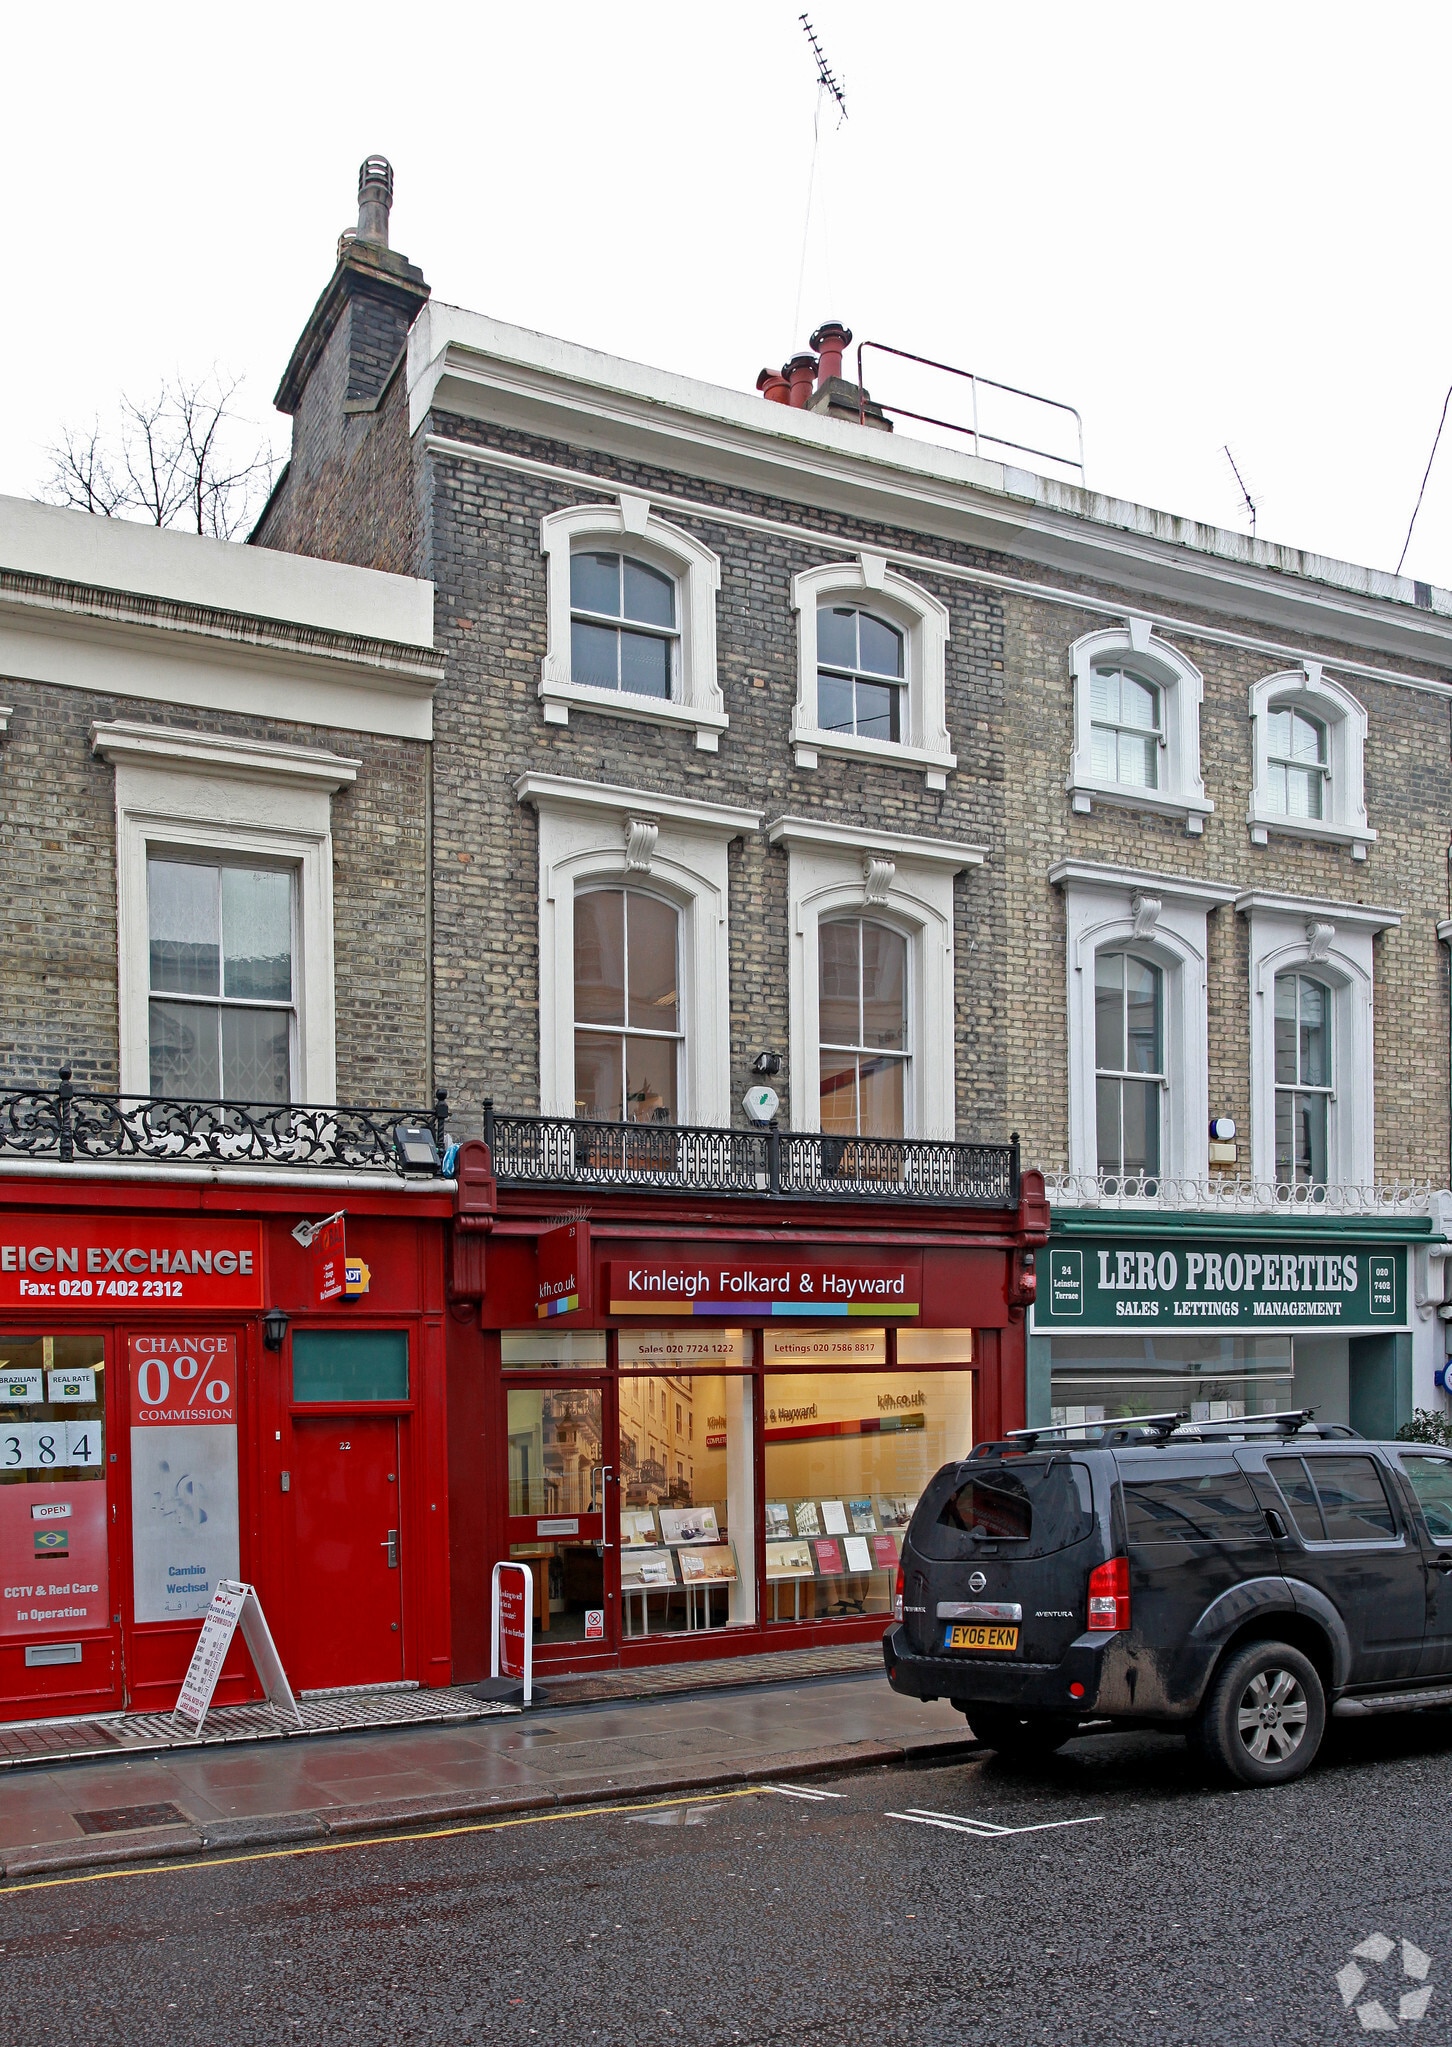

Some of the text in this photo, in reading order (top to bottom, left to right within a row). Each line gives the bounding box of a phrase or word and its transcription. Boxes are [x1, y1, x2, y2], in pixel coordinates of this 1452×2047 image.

[569, 1227, 576, 1237] 23
[1, 1246, 253, 1275] EIGN EXCHANGE
[1061, 1265, 1072, 1275] 24
[1097, 1250, 1358, 1292] LERO PROPERTIES
[1375, 1268, 1389, 1276] 020
[19, 1279, 183, 1297] Fax: 020 7402 2312
[539, 1273, 576, 1298] kfh.co.uk
[628, 1269, 905, 1298] Kinleigh Folkard & Hayward
[1053, 1279, 1080, 1288] Leinster
[1374, 1281, 1391, 1290] 7402
[1054, 1291, 1079, 1300] Terrace
[1374, 1294, 1391, 1303] 7768
[1115, 1300, 1342, 1317] SALES LETTINGS MANAGEMENT
[135, 1337, 228, 1353] CHANGE
[638, 1344, 734, 1354] Sales 020 7724 1222
[774, 1343, 875, 1354] Lettings 020 7586 8817
[52, 1375, 90, 1384] REAL RATE
[138, 1354, 230, 1406] 0%
[877, 1389, 924, 1409] kfh.co.uk
[138, 1408, 233, 1421] COMMISSION
[778, 1402, 817, 1421] Hayward
[339, 1441, 351, 1450] 22
[40, 1505, 66, 1516] OPEN
[168, 1564, 206, 1576] Cambio
[4, 1583, 99, 1598] CCTV & Red Care
[166, 1582, 209, 1594] Wechsel
[17, 1606, 87, 1622] in Operation
[952, 1627, 1016, 1646] EY06 EKN
